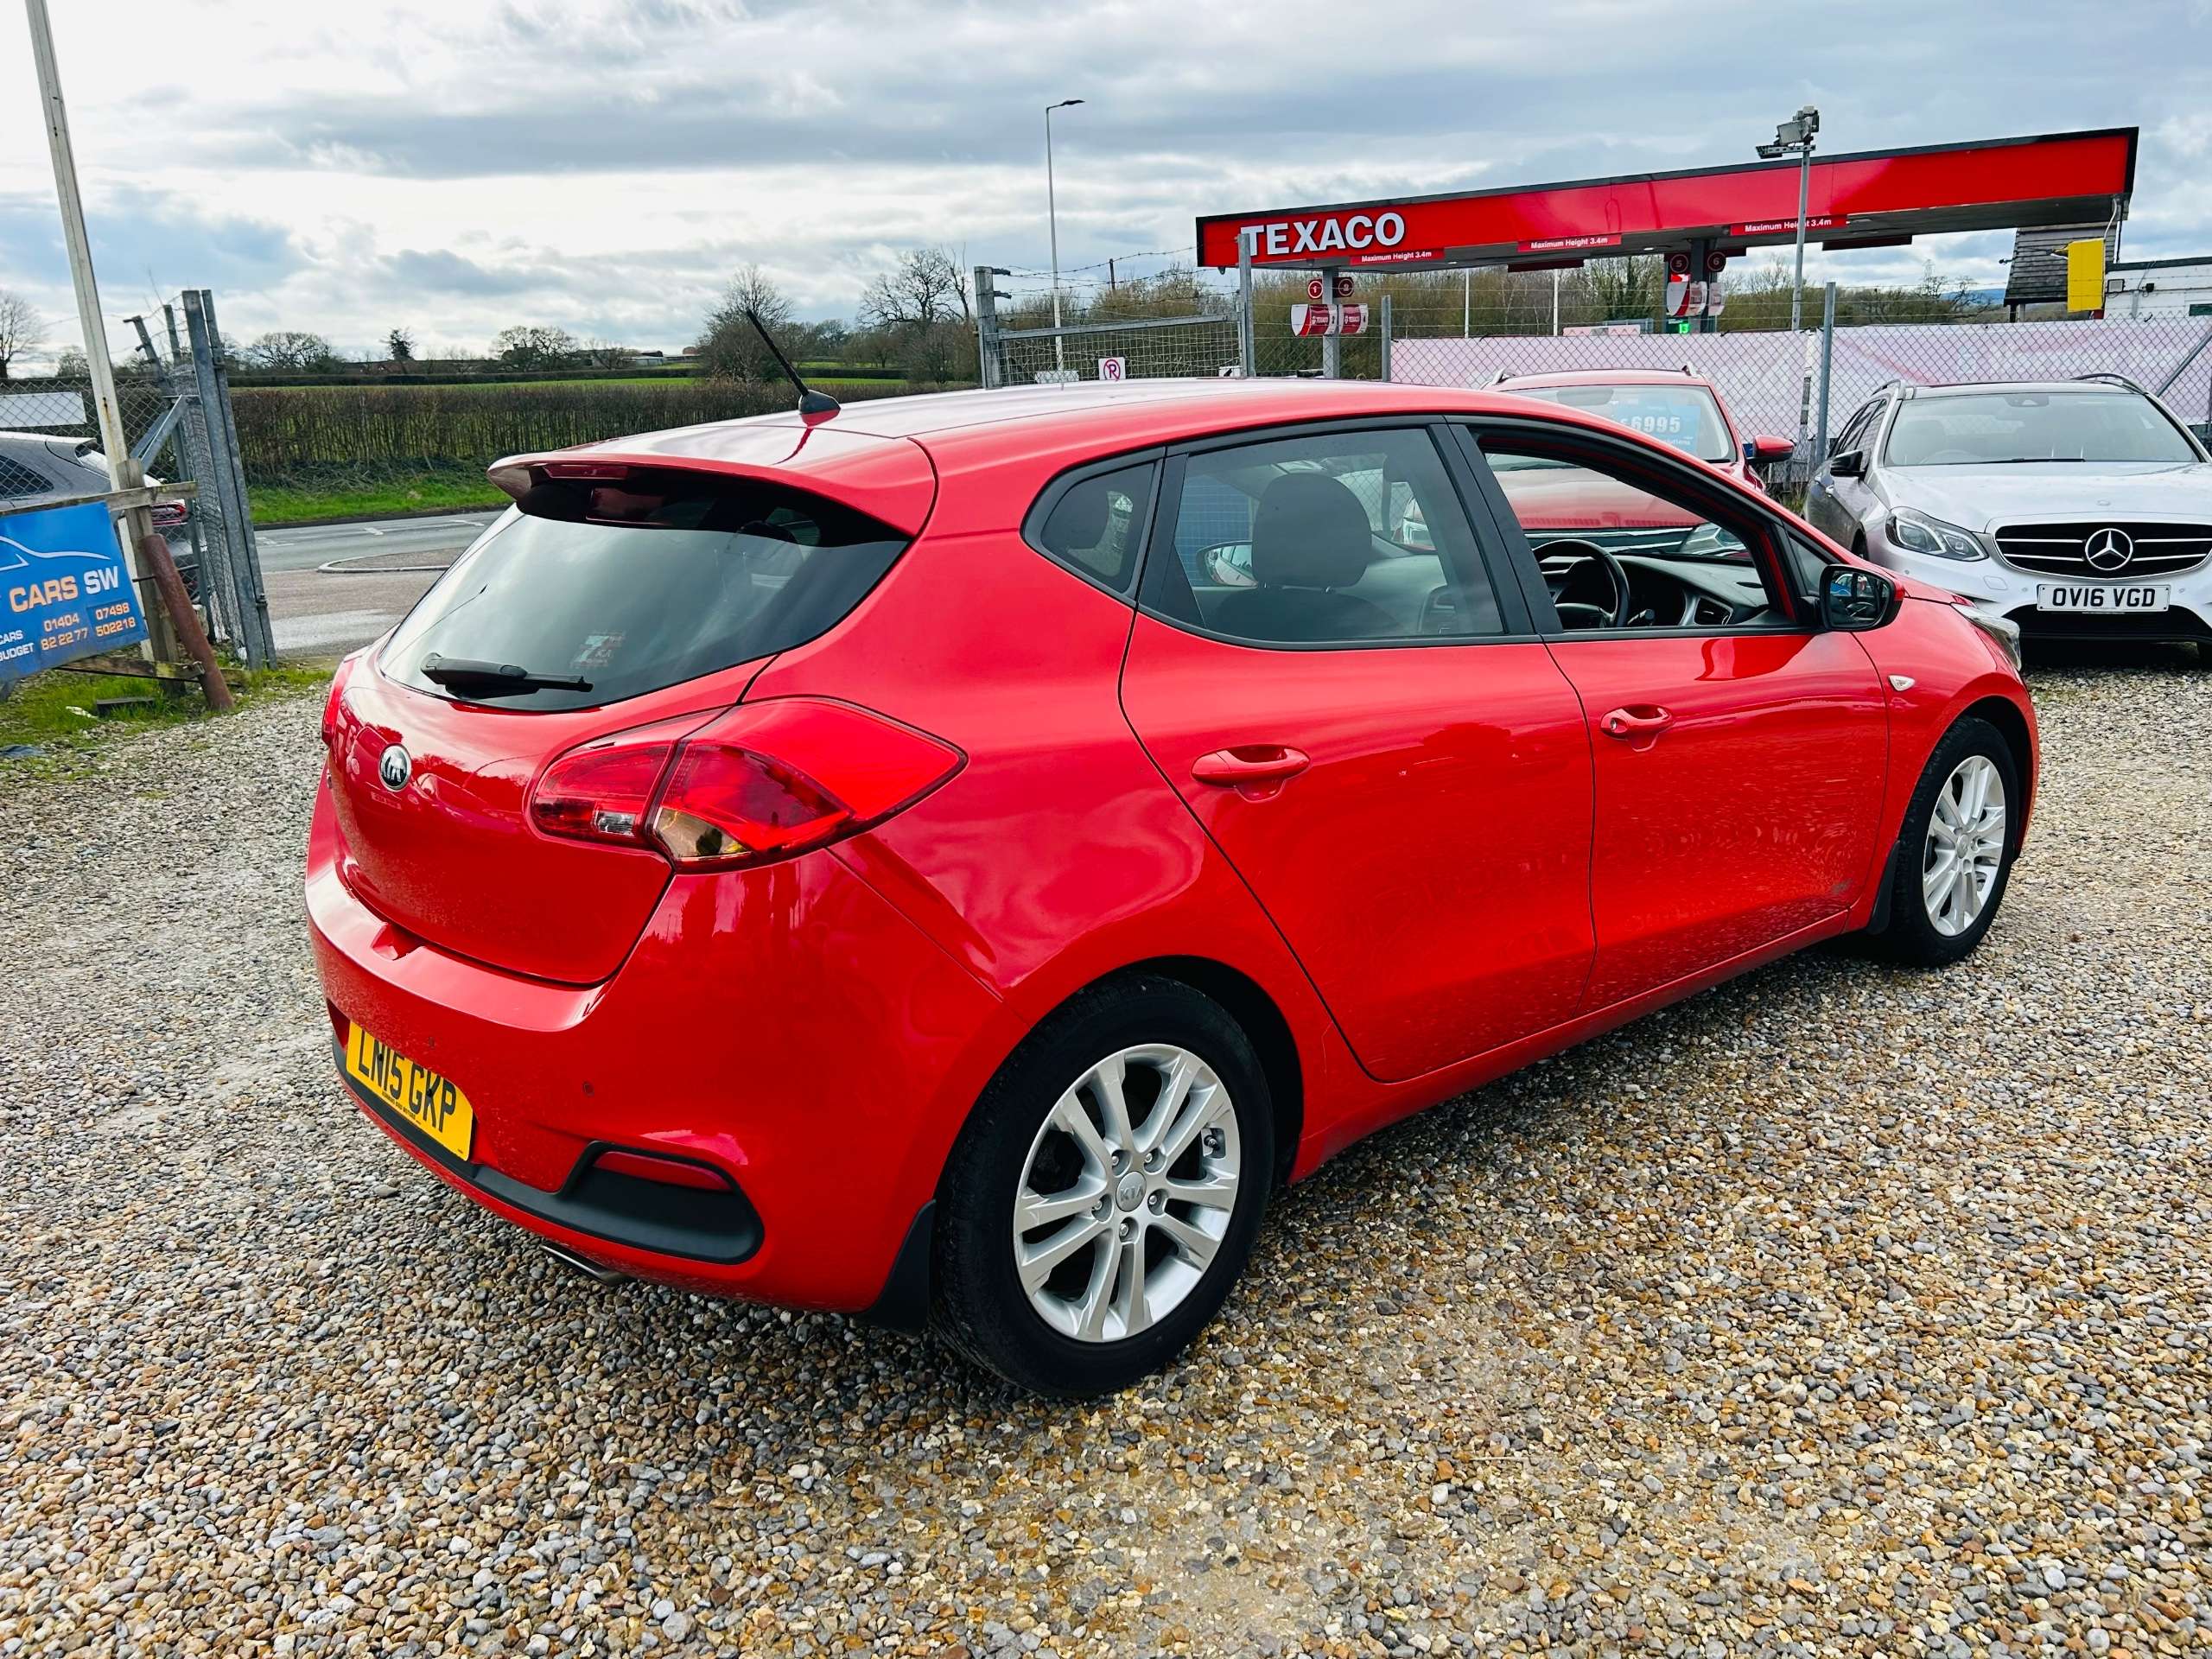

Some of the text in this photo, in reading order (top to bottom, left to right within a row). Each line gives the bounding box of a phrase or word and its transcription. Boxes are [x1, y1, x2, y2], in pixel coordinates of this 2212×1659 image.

[1240, 213, 1405, 257] TEXACO
[1745, 219, 1832, 232] Maximum Heit 3.4m
[1565, 238, 1588, 247] Height
[1361, 254, 1391, 263] Maximum
[1393, 251, 1414, 260] Height
[10, 566, 118, 613] CARS SW
[2052, 588, 2156, 607] OV16 VGD
[95, 602, 130, 620] 07498
[43, 613, 79, 632] 01404
[95, 617, 137, 637] 502218
[41, 627, 88, 650] 82 22 77
[358, 1030, 405, 1100] LN15
[409, 1061, 457, 1134] GKP
[1120, 1185, 1144, 1202] KIA
